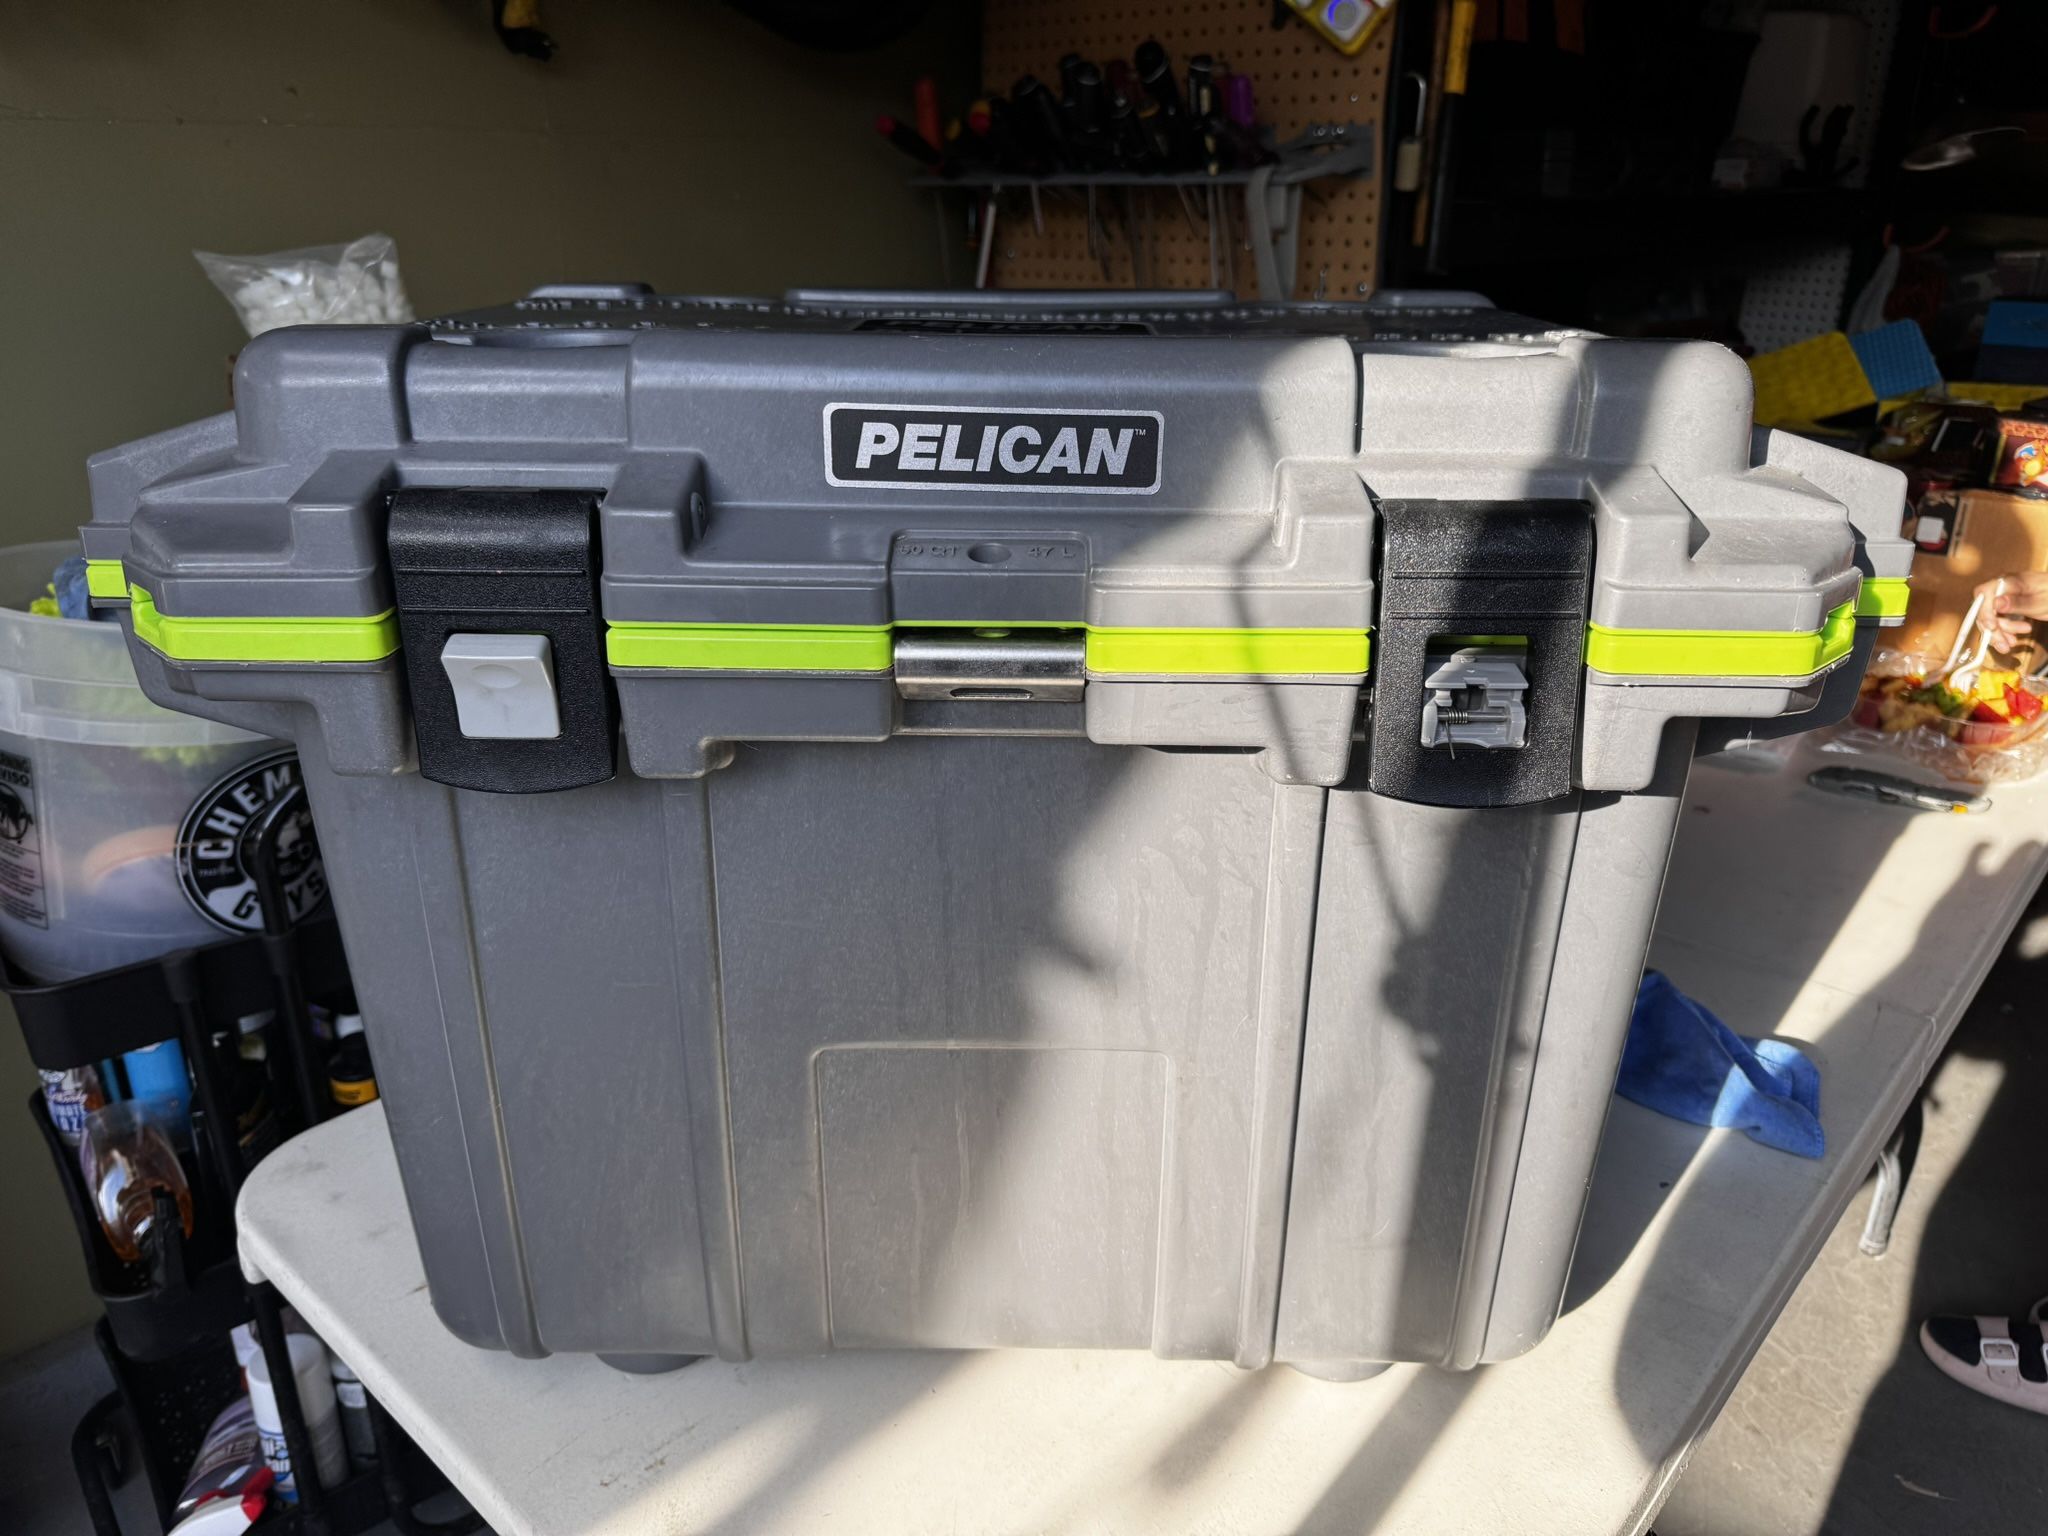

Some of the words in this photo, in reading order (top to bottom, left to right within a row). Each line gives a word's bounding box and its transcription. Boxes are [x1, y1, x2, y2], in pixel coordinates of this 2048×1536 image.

[855, 421, 1133, 475] PELICAN
[1027, 547, 1056, 558] 47
[1063, 547, 1077, 558] L
[234, 874, 325, 920] GYS
